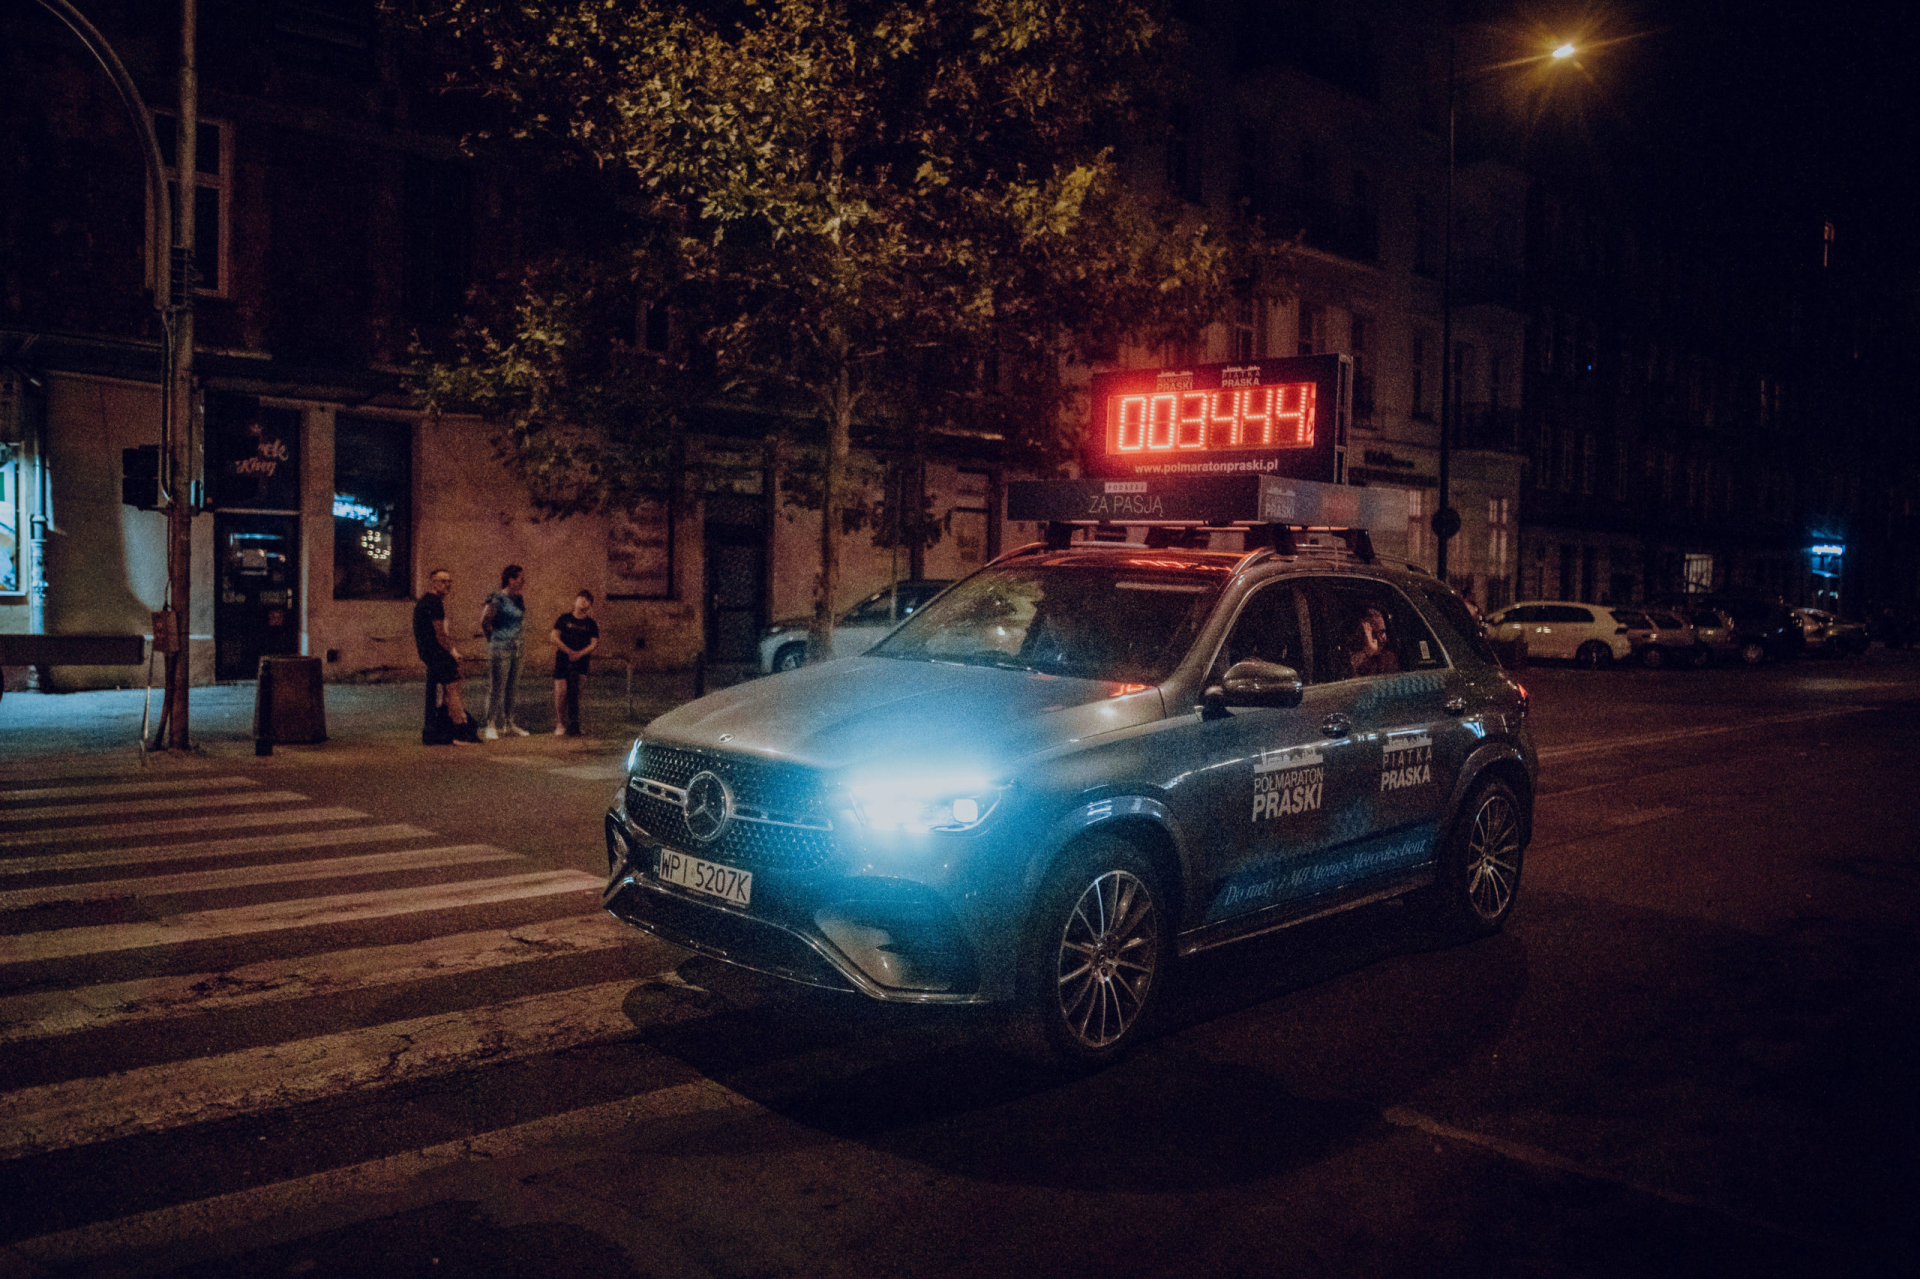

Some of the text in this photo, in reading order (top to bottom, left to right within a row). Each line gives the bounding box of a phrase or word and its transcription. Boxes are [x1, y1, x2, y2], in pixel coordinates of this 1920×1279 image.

[1221, 377, 1260, 388] PRASKA
[1134, 458, 1279, 475] www.polmaratonpraski.pl
[1087, 494, 1164, 517] ZA PASJĄ
[1380, 763, 1431, 792] PRASKA
[1251, 782, 1323, 823] PRASKI
[695, 862, 749, 902] 5207K
